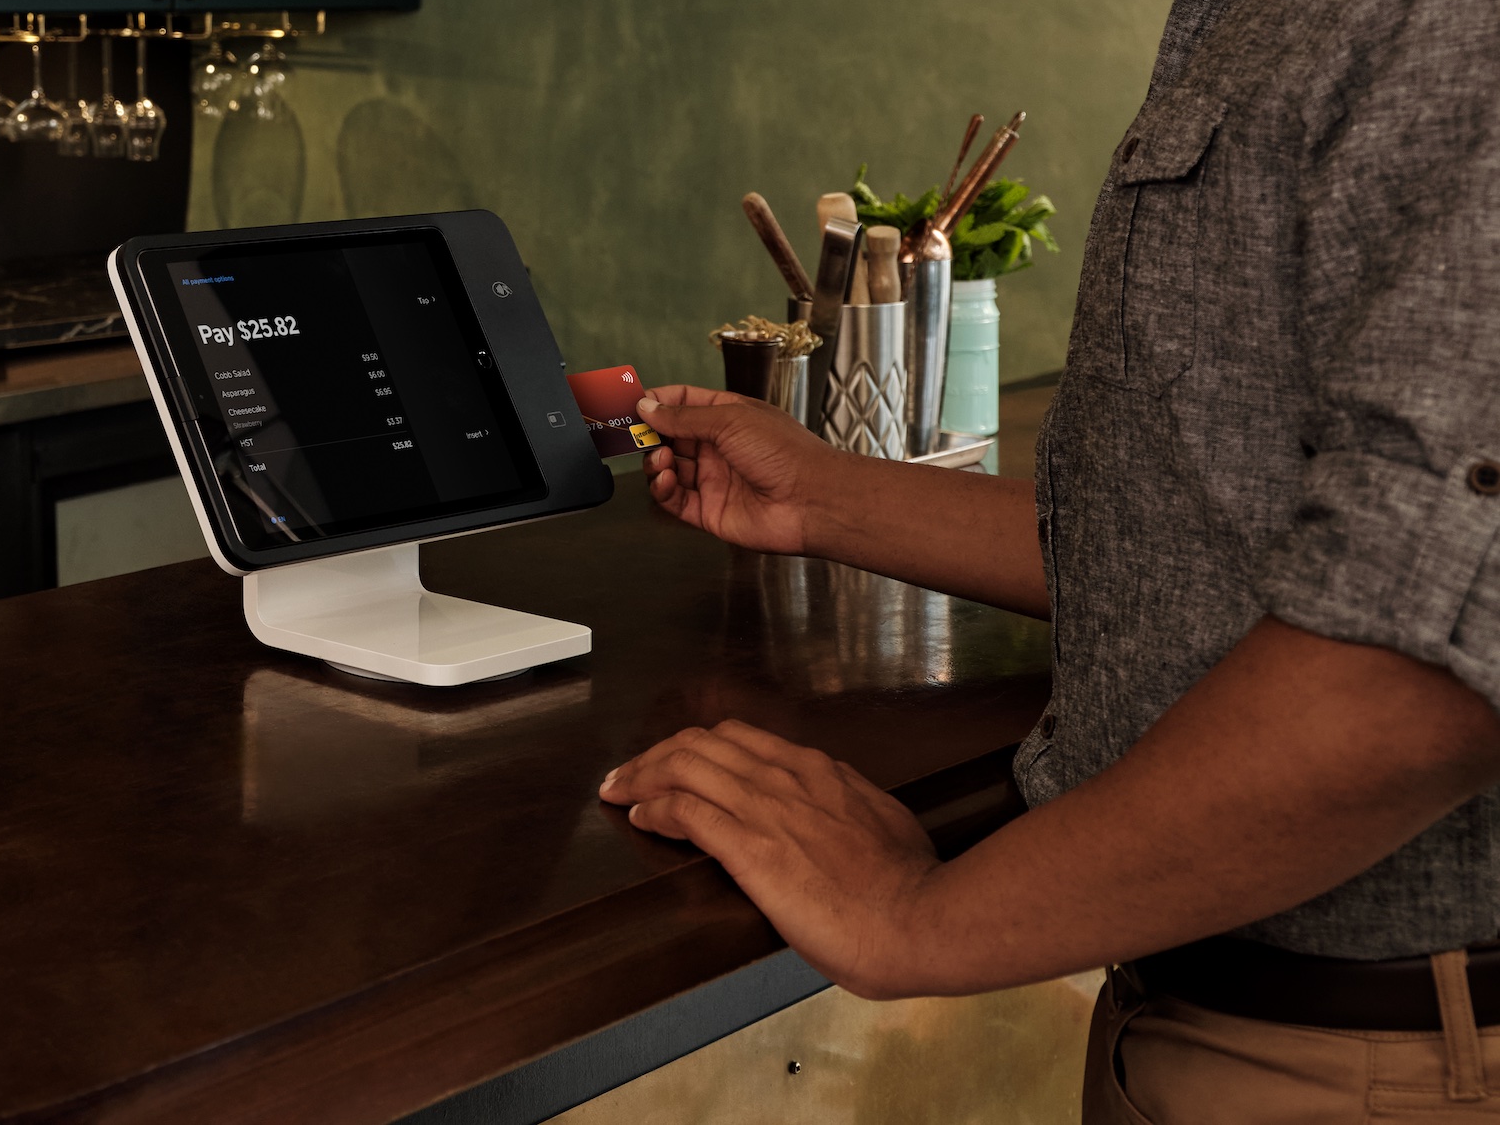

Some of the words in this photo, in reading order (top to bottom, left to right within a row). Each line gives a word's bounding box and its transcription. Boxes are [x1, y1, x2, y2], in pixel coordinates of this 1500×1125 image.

[182, 278, 190, 286] All
[190, 276, 213, 286] payment
[214, 274, 235, 284] options
[417, 296, 430, 305] Tap
[197, 324, 234, 346] Pay
[236, 315, 300, 340] $25.82
[214, 370, 233, 380] Cobb
[233, 368, 252, 378] Salad
[368, 370, 386, 379] $6.00
[222, 387, 255, 398] Asparagus
[227, 404, 267, 416] Cheesecake
[232, 419, 263, 430] Strawberry
[608, 416, 633, 428] 9010
[465, 429, 483, 441] Insert
[239, 438, 254, 448] HST
[249, 463, 267, 473] Total
